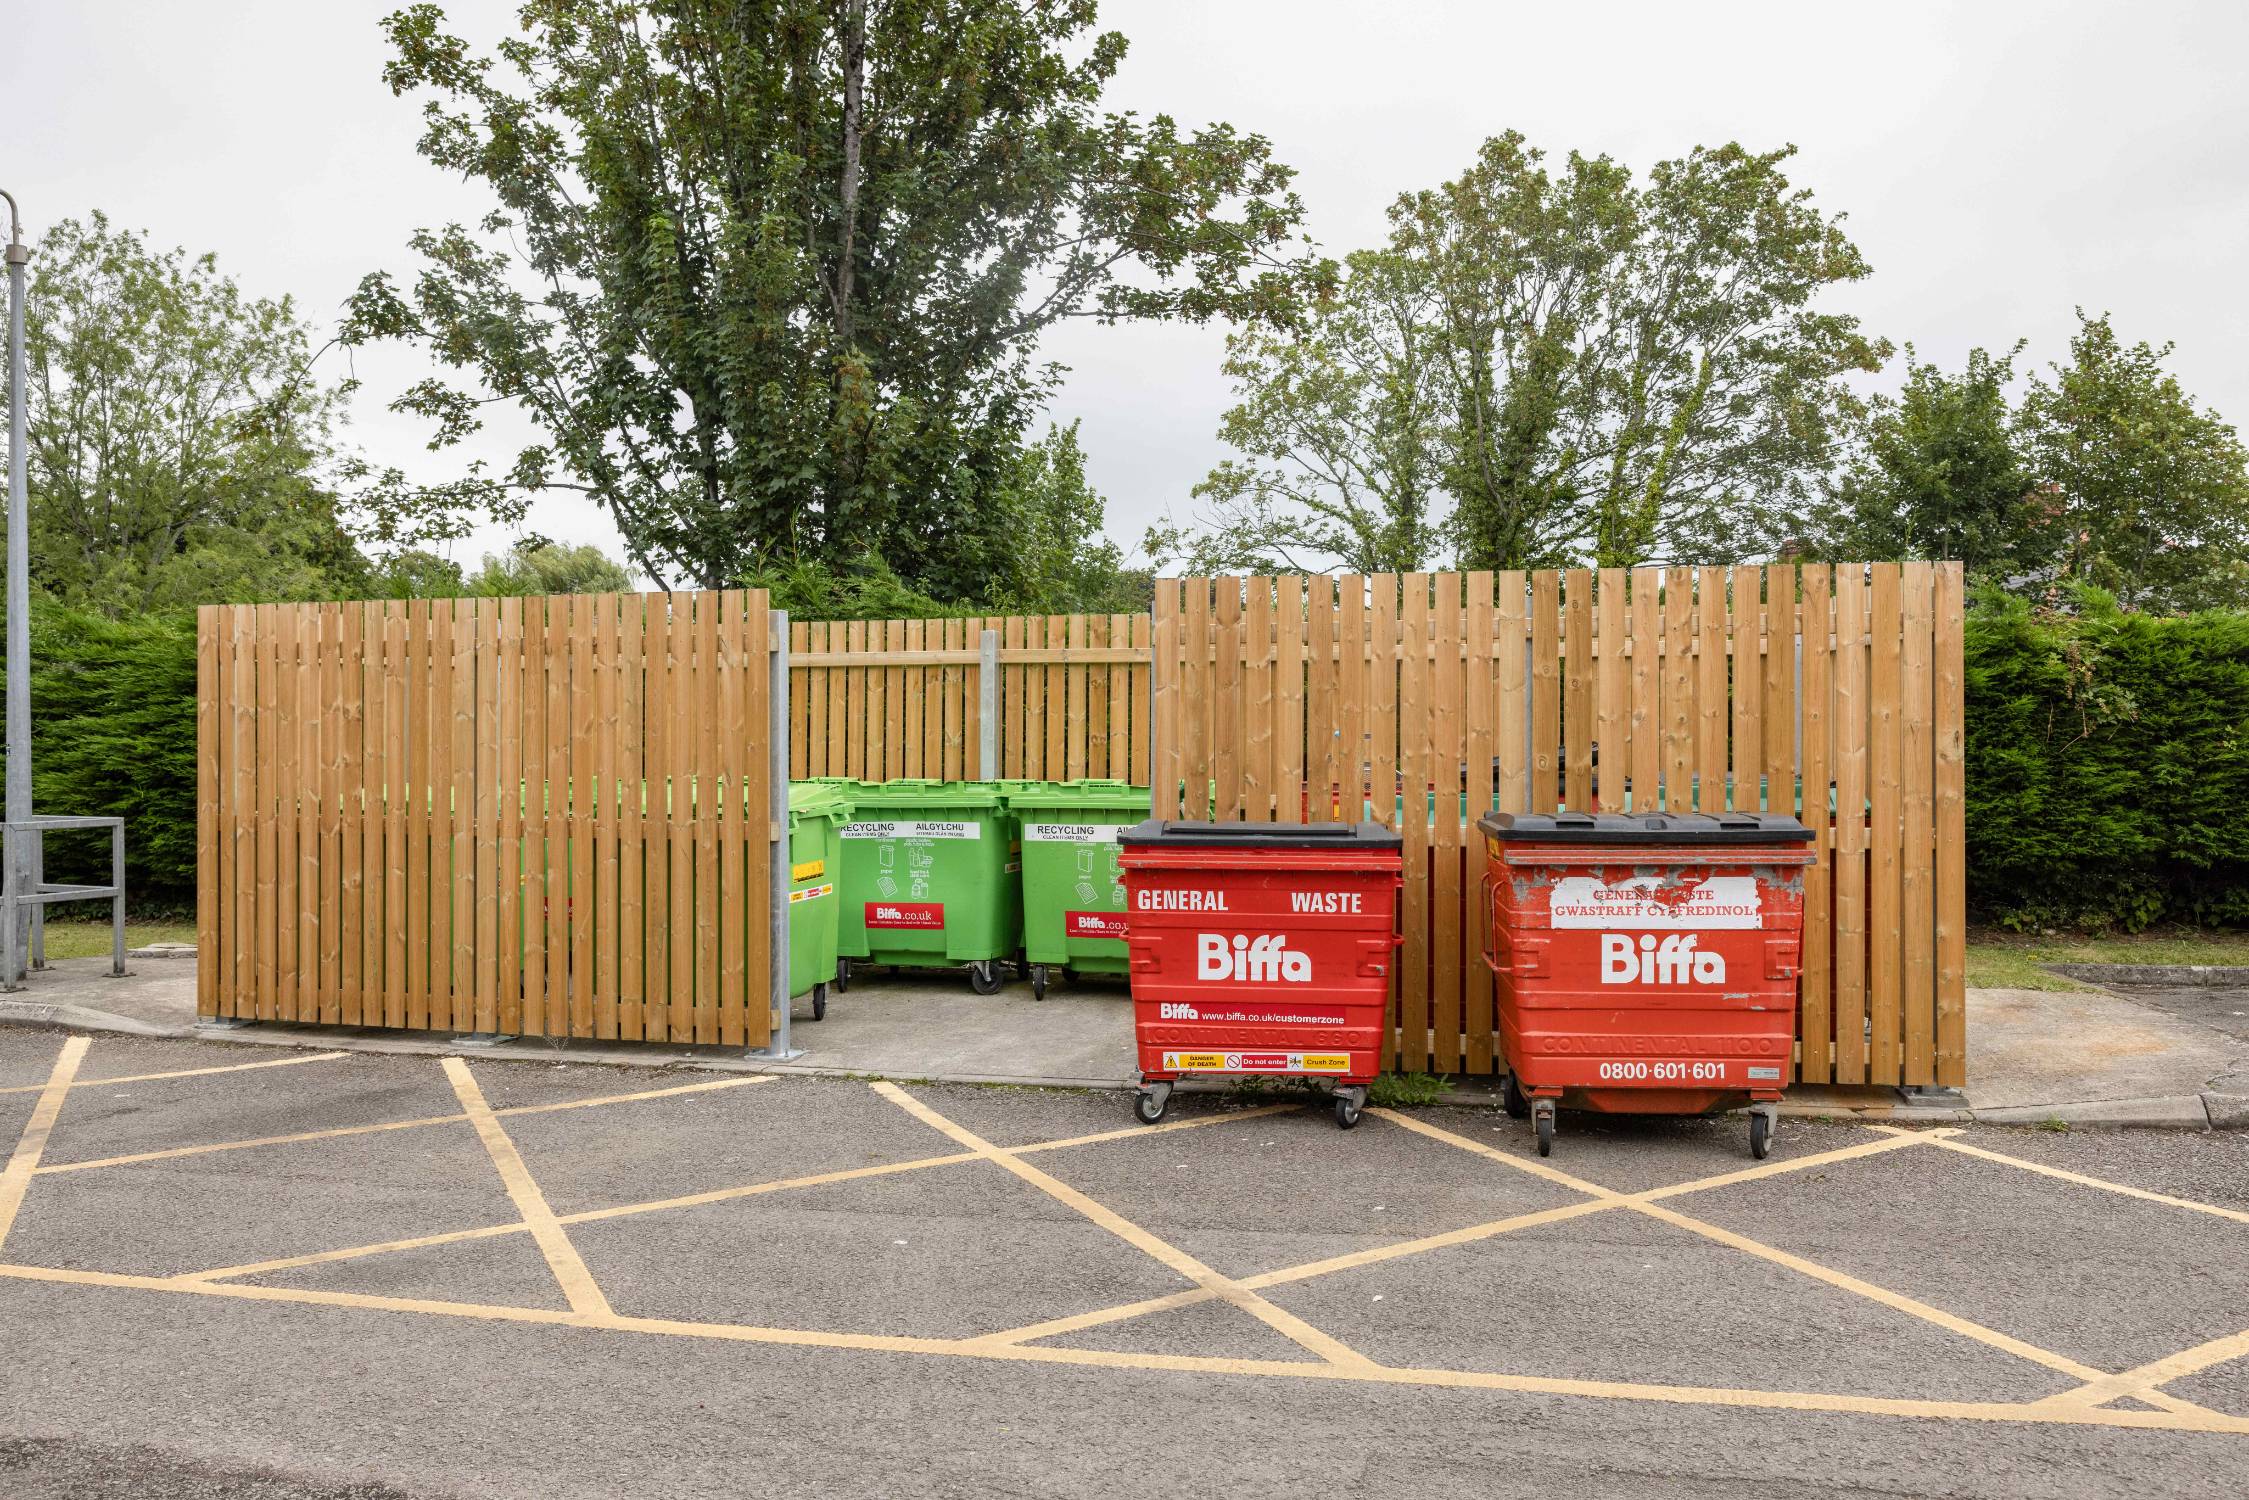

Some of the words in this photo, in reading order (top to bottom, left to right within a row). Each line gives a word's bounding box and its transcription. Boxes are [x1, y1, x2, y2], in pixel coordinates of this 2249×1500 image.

[840, 823, 895, 832] RECYCLING
[915, 823, 964, 831] AILGYLCHU
[1037, 825, 1094, 835] RECYCLING
[1137, 889, 1229, 911] GENERAL
[1290, 891, 1362, 913] WASTE
[876, 907, 932, 921] Biffa.co.uk
[1555, 905, 1643, 916] GWASTRAFF
[1197, 933, 1312, 982] Biffa
[1601, 933, 1726, 984] Biffa
[1160, 1003, 1199, 1020] Biffa
[1201, 1010, 1345, 1025] www.biffa.co.uk/customerzone
[1243, 1057, 1254, 1066] Do
[1255, 1058, 1267, 1066] not
[1268, 1058, 1287, 1066] enter
[1306, 1058, 1328, 1067] Crush
[1328, 1058, 1346, 1067] Zone
